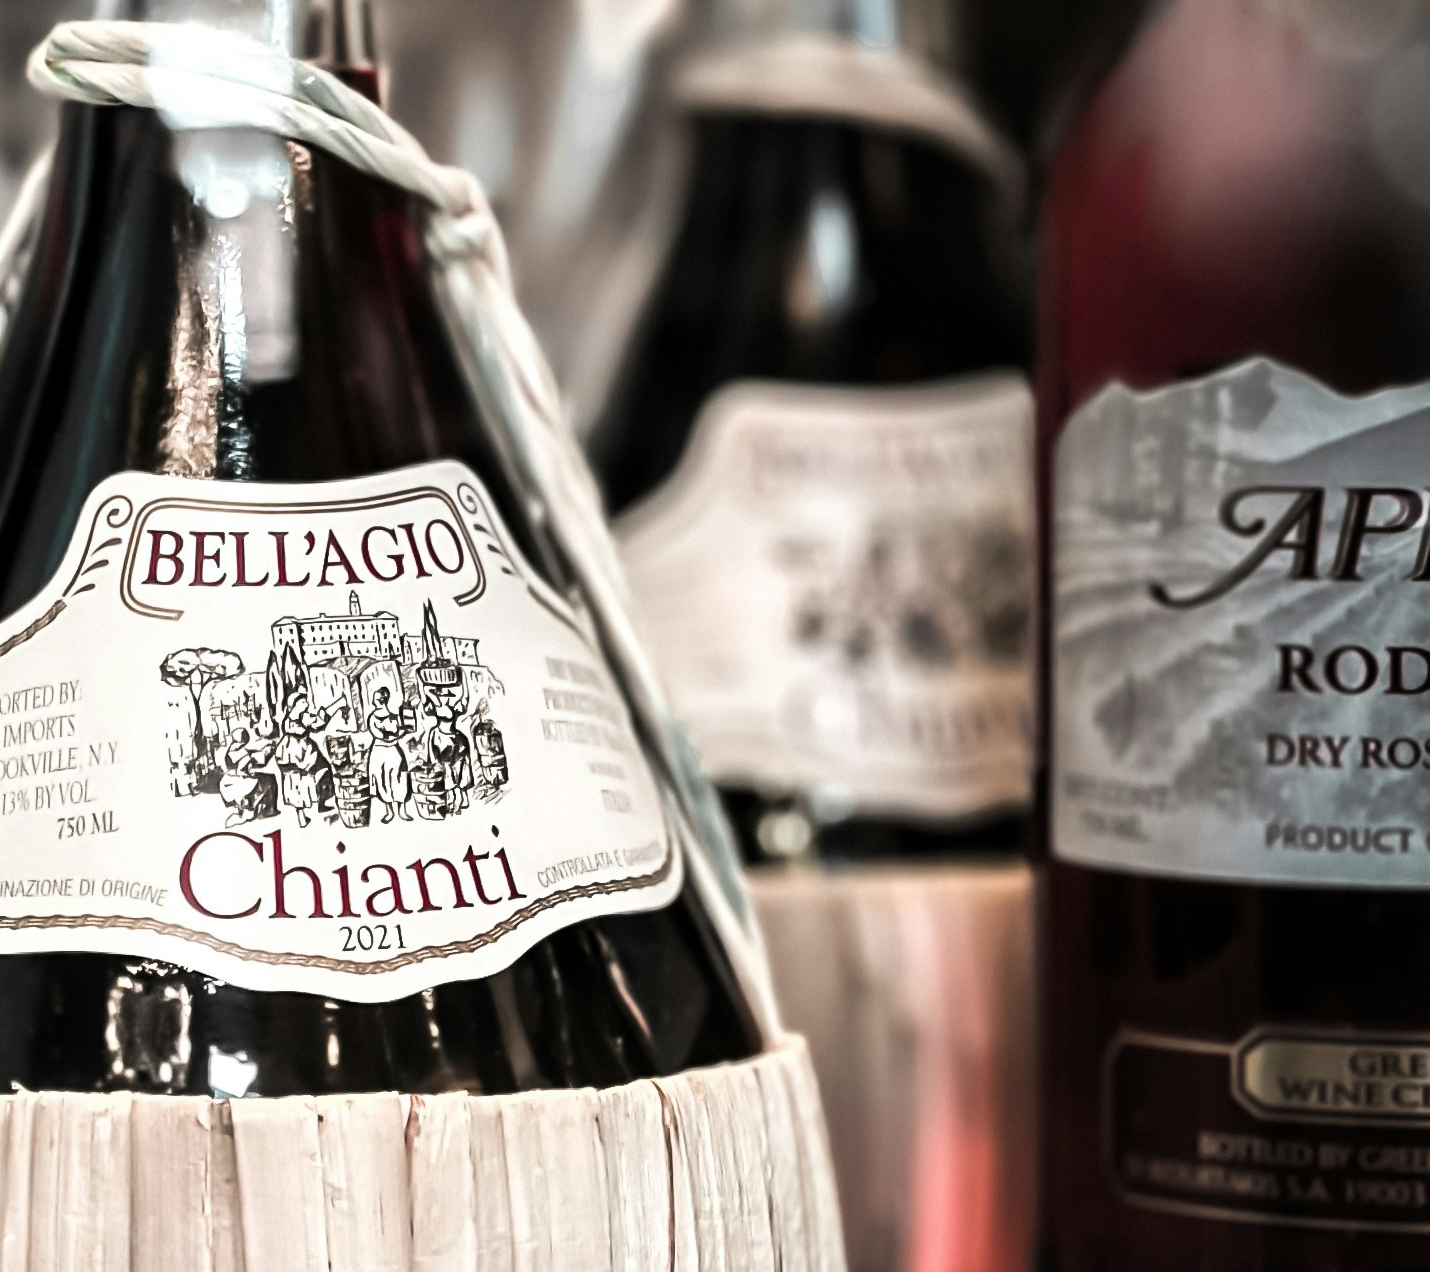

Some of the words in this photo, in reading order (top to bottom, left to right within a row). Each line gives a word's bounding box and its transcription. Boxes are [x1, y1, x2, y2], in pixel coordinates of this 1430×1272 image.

[141, 518, 465, 587] BELL'AGIO
[3, 714, 76, 748] IMPORTS
[1266, 733, 1350, 769] DRY
[2, 789, 31, 817] 13%
[35, 783, 56, 811] BY
[57, 815, 87, 841] 750
[90, 810, 120, 835] ML
[1265, 823, 1414, 855] PRODUCT
[179, 824, 528, 921] Chianti
[537, 851, 614, 888] CONTROLLATA
[79, 879, 95, 897] DI
[101, 878, 169, 907] ORIGINE
[338, 924, 408, 952] 2021
